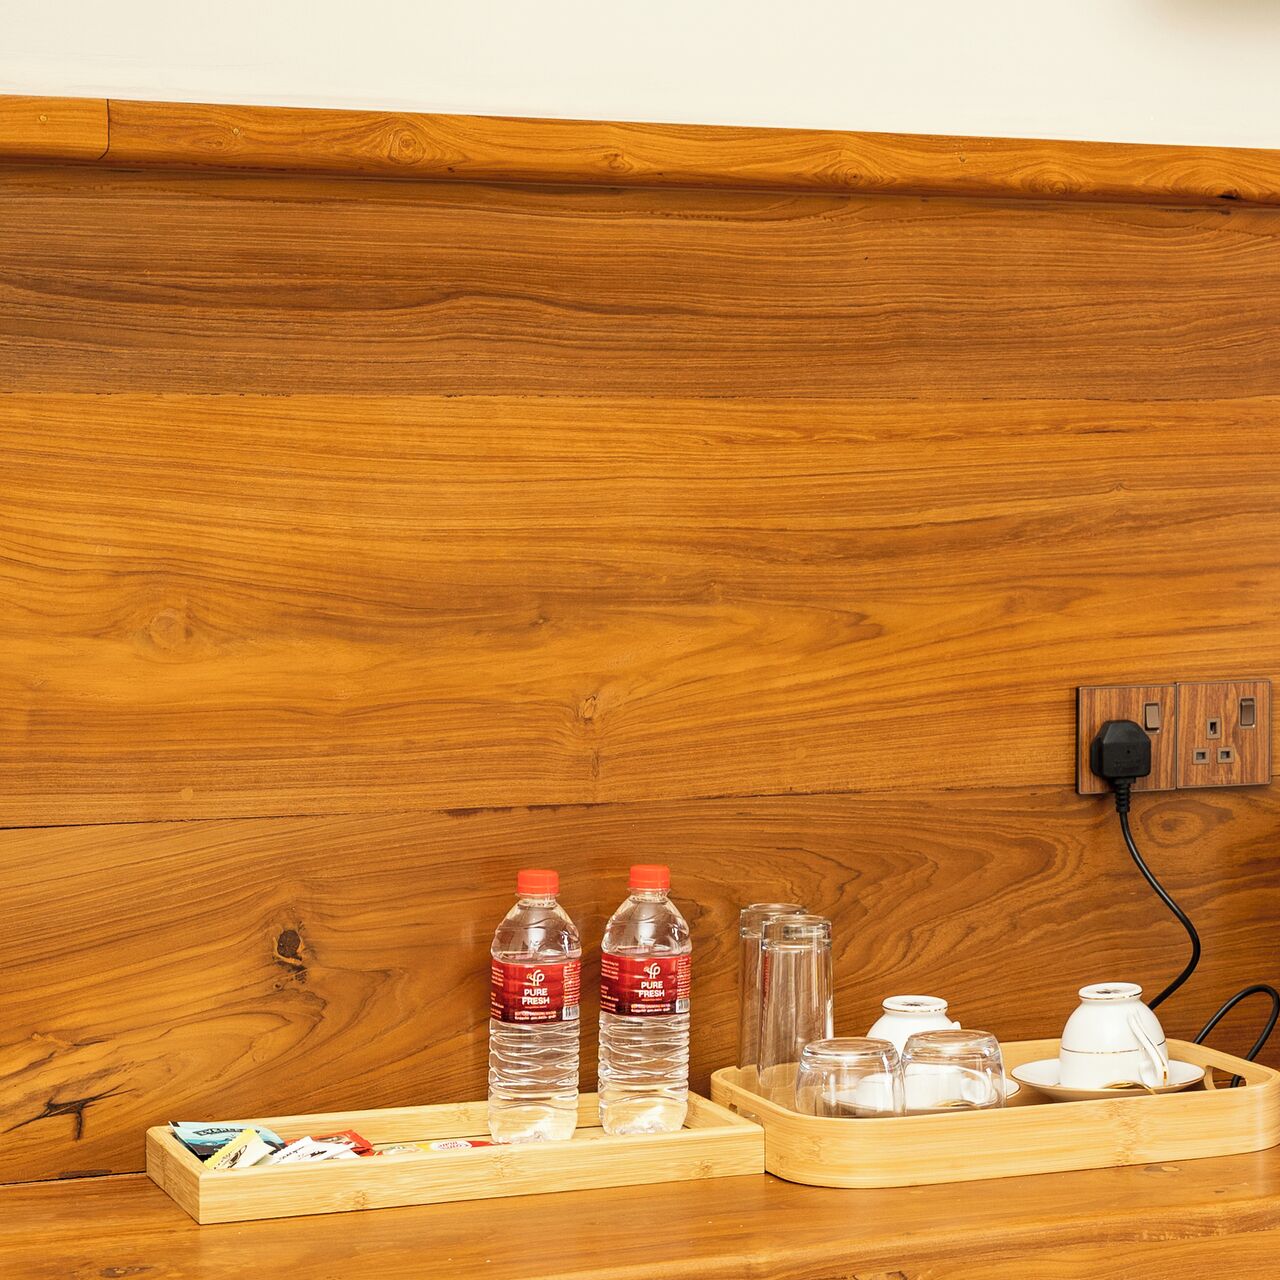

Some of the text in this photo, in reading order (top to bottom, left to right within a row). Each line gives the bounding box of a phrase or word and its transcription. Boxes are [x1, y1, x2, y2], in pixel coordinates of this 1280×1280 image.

[640, 980, 664, 989] PURE
[523, 987, 548, 997] PURE
[638, 989, 665, 998] FRESH
[521, 996, 550, 1006] FRESH
